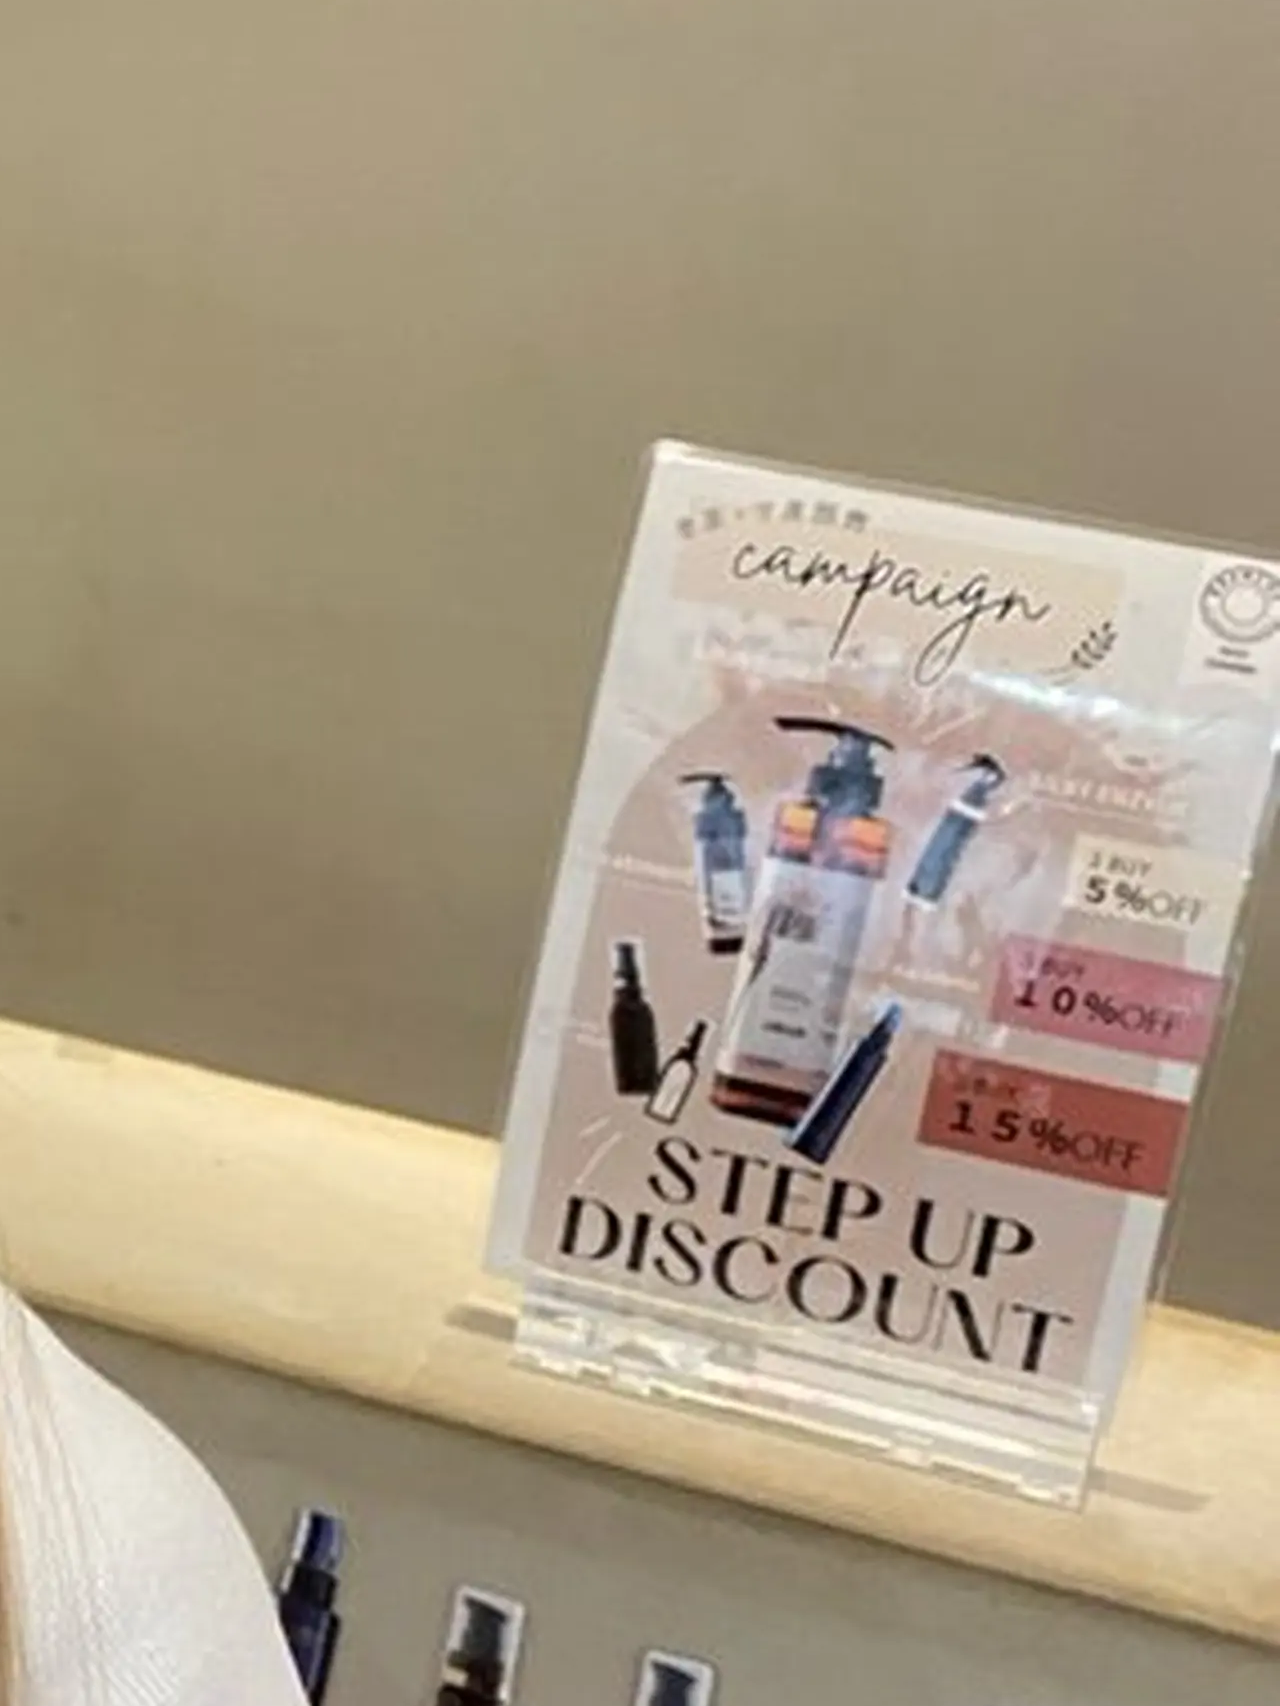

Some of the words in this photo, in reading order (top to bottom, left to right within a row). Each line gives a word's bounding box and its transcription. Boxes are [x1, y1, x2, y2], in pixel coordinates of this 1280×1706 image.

[732, 543, 1050, 686] campaign
[648, 1136, 882, 1241] STEP
[909, 1197, 1035, 1278] UP
[559, 1195, 1074, 1373] DISCOUNT
